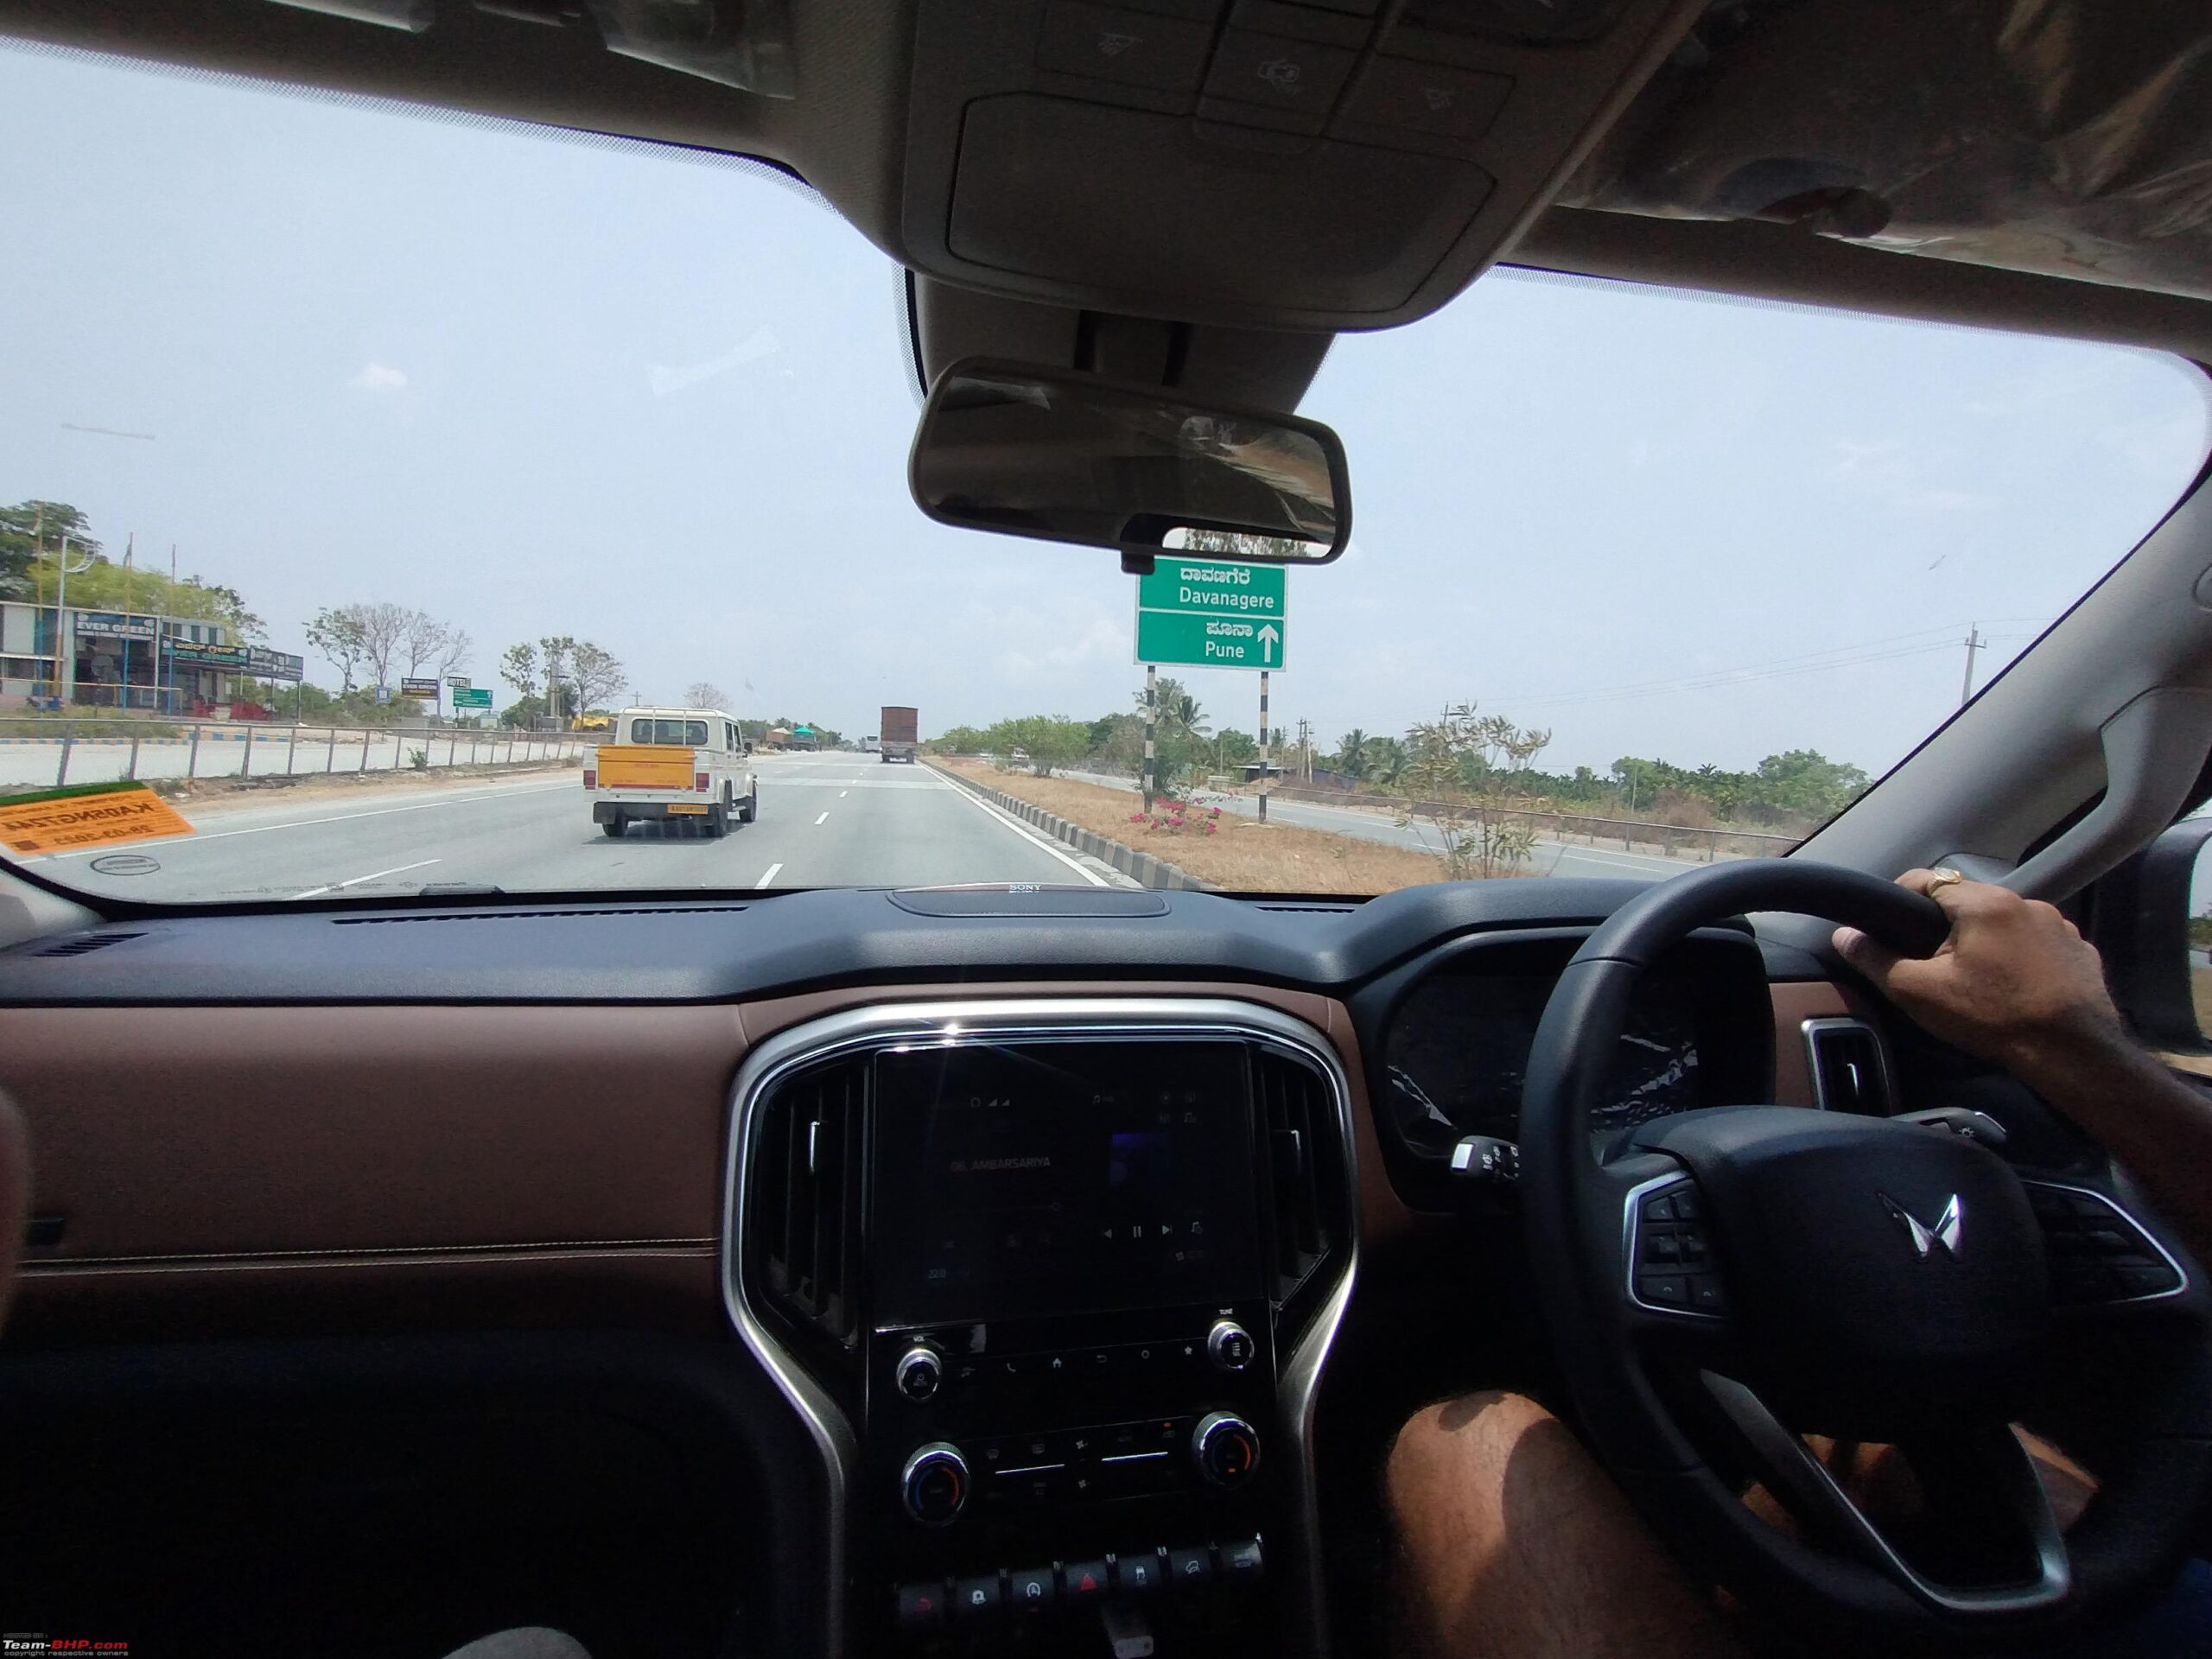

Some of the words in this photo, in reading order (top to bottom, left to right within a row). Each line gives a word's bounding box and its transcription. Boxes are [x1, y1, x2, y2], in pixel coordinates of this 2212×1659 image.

[1180, 567, 1250, 585] ದಾವಣಗೆರೆ
[1179, 587, 1274, 609] Davanagere
[77, 621, 109, 631] EVER
[1205, 641, 1245, 658] Pune
[448, 677, 467, 687] HOTEL
[971, 1156, 1052, 1170] AMBARSARIYA
